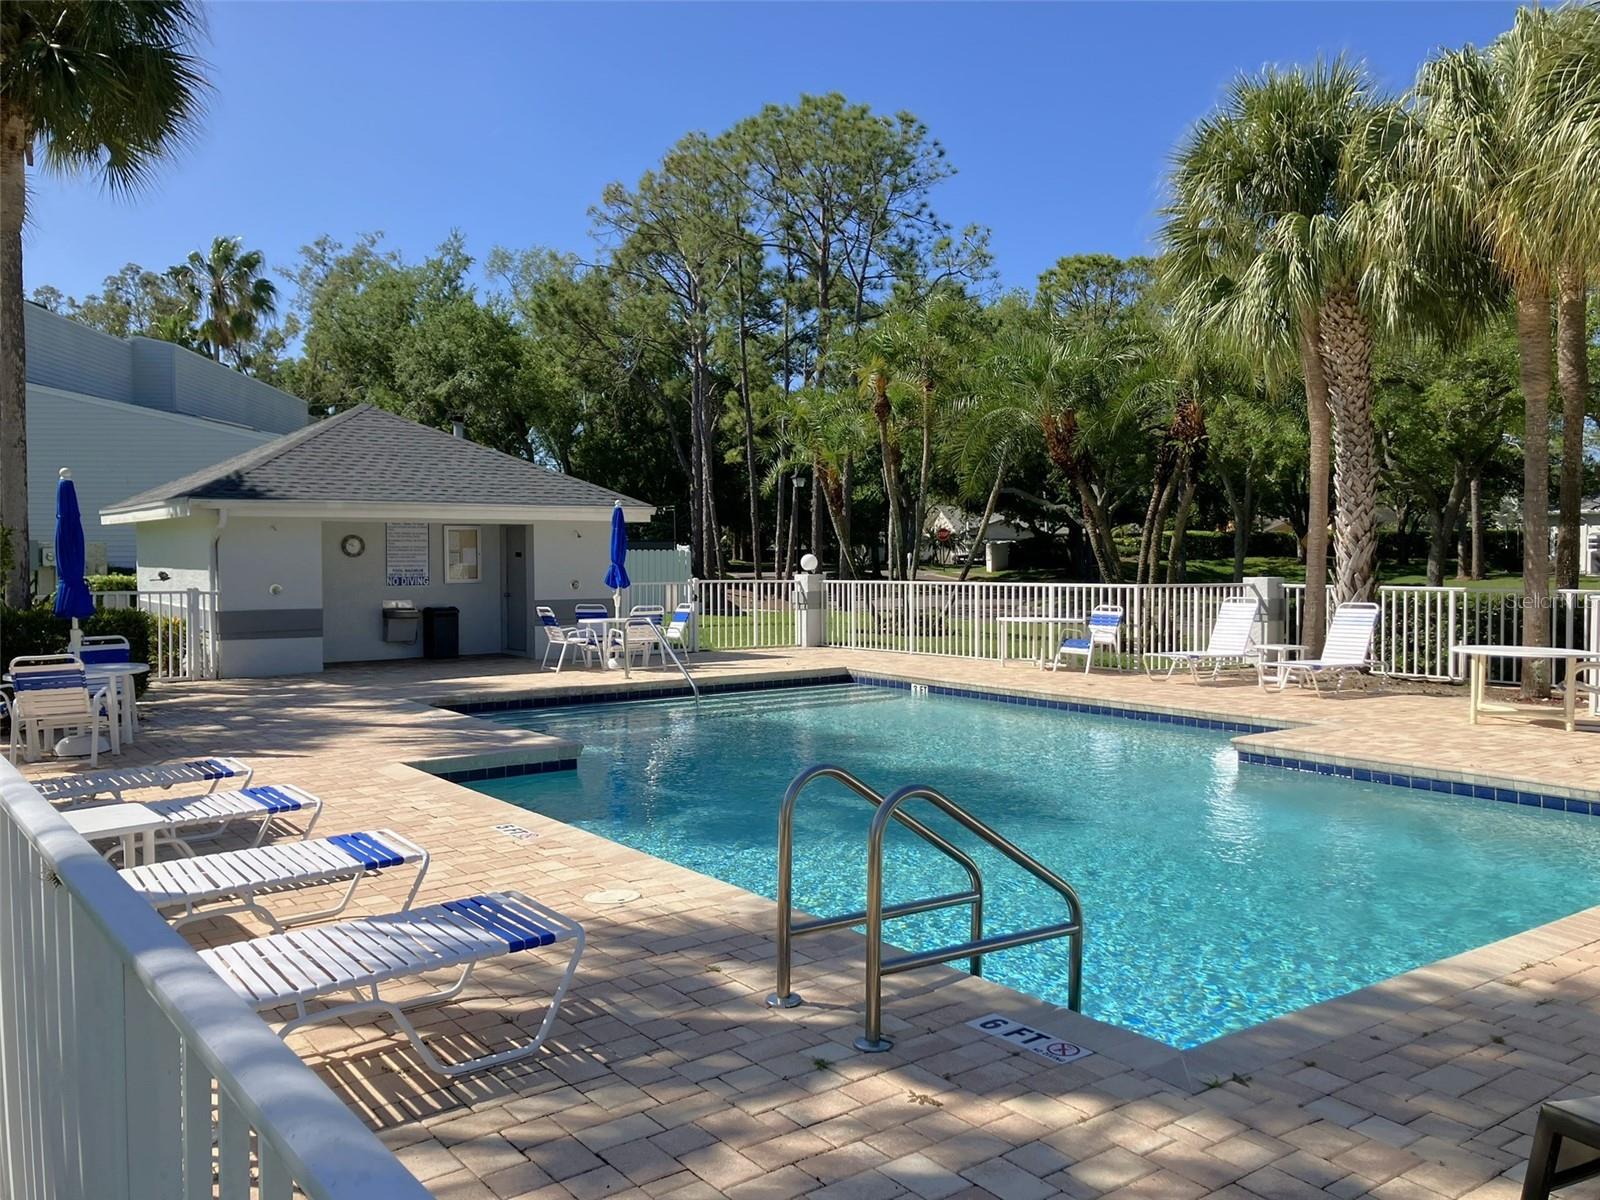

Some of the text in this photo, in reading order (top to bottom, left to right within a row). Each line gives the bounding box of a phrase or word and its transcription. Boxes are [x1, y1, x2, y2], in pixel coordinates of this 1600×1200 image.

[387, 577, 429, 586] NO DIVING
[979, 1019, 1052, 1045] 6 FT
